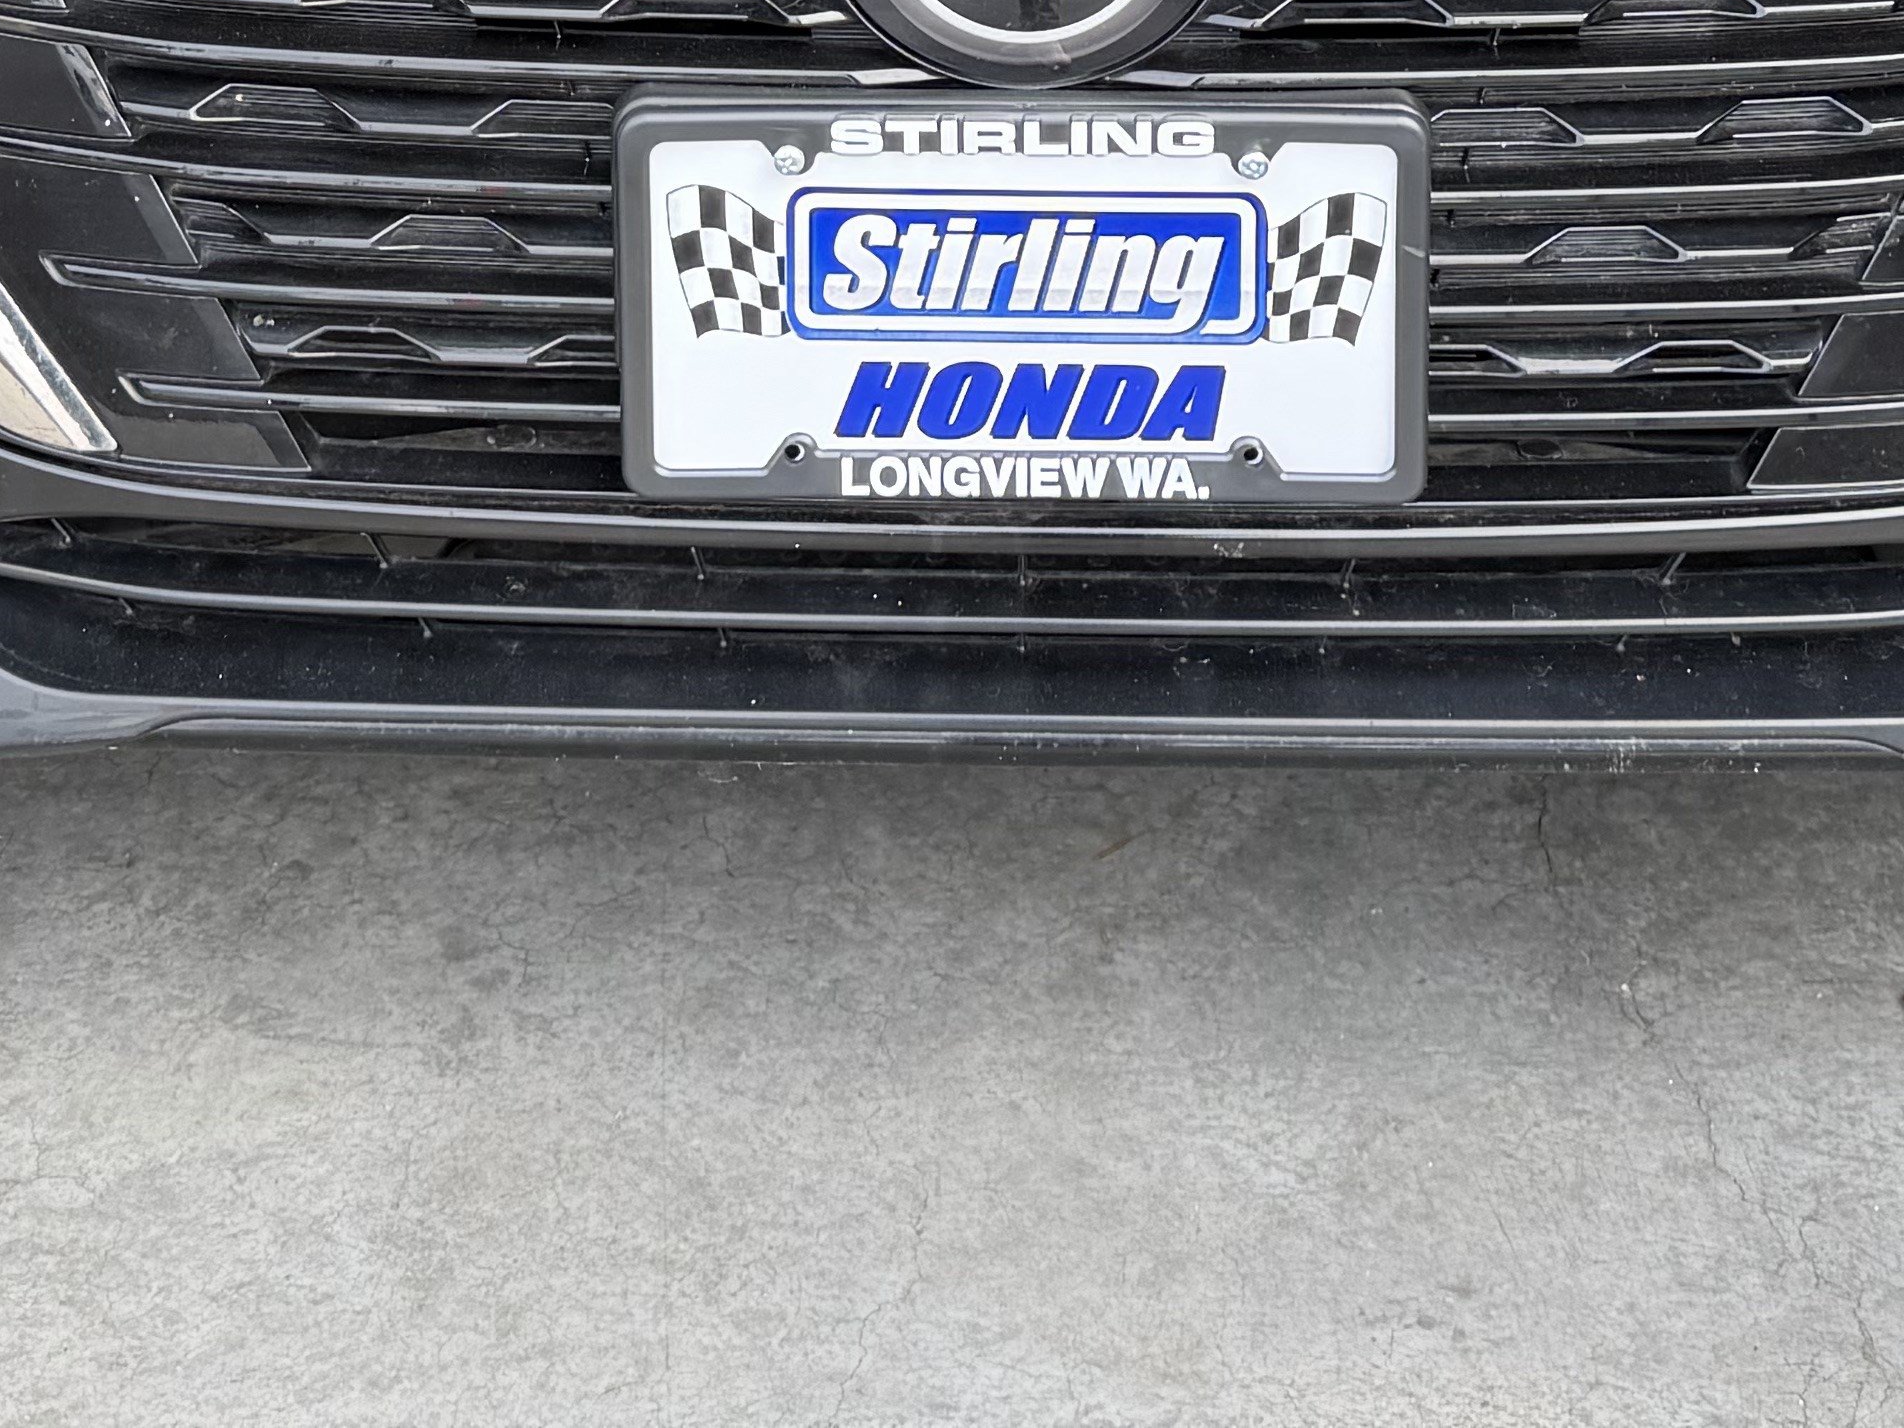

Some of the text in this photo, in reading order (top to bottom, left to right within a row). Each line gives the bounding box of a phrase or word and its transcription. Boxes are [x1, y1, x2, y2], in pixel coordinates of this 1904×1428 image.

[830, 115, 1216, 158] STIRLING
[822, 213, 1225, 333] Stirling
[833, 360, 1227, 442] HONDA
[839, 456, 1211, 500] LONGVIEW WA.
